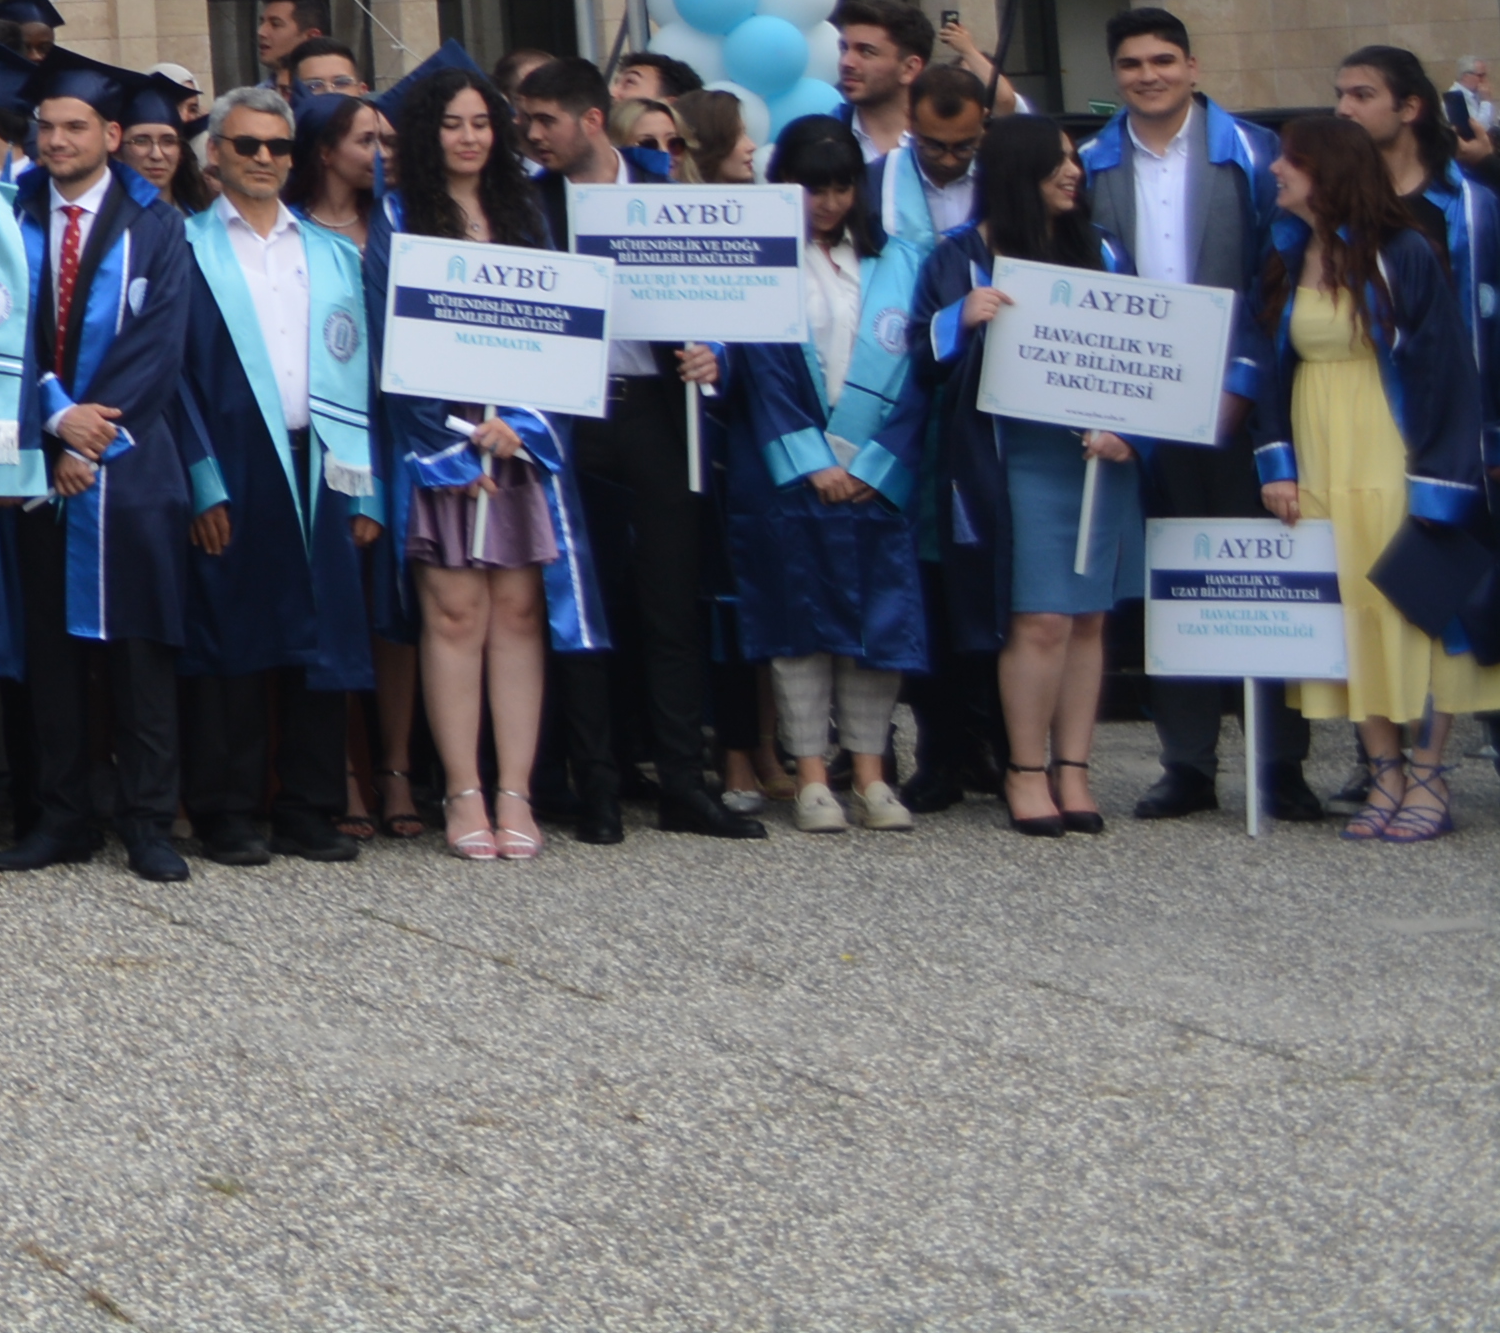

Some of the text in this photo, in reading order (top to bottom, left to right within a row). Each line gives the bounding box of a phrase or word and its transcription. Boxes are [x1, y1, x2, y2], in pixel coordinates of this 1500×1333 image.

[655, 199, 744, 225] AYBÜ
[702, 240, 720, 251] VE
[722, 238, 761, 251] DOĞA
[473, 263, 559, 292] AYBÜ
[616, 273, 677, 288] TALURJİ
[517, 304, 533, 315] VE
[535, 306, 571, 320] DOĞA
[1078, 289, 1172, 320] AYBÜ
[456, 332, 542, 352] MATEMATİK
[1034, 324, 1173, 358] HAVACILIK VE
[1018, 344, 1182, 382] UZAY BİLİMLERİ
[1046, 370, 1153, 400] FAKÜLTESİ
[1217, 534, 1295, 560] AYBÜ
[1265, 576, 1280, 586] VE
[1171, 586, 1198, 597] UZAY
[1272, 610, 1289, 621] VE
[1177, 623, 1209, 635] UZAY
